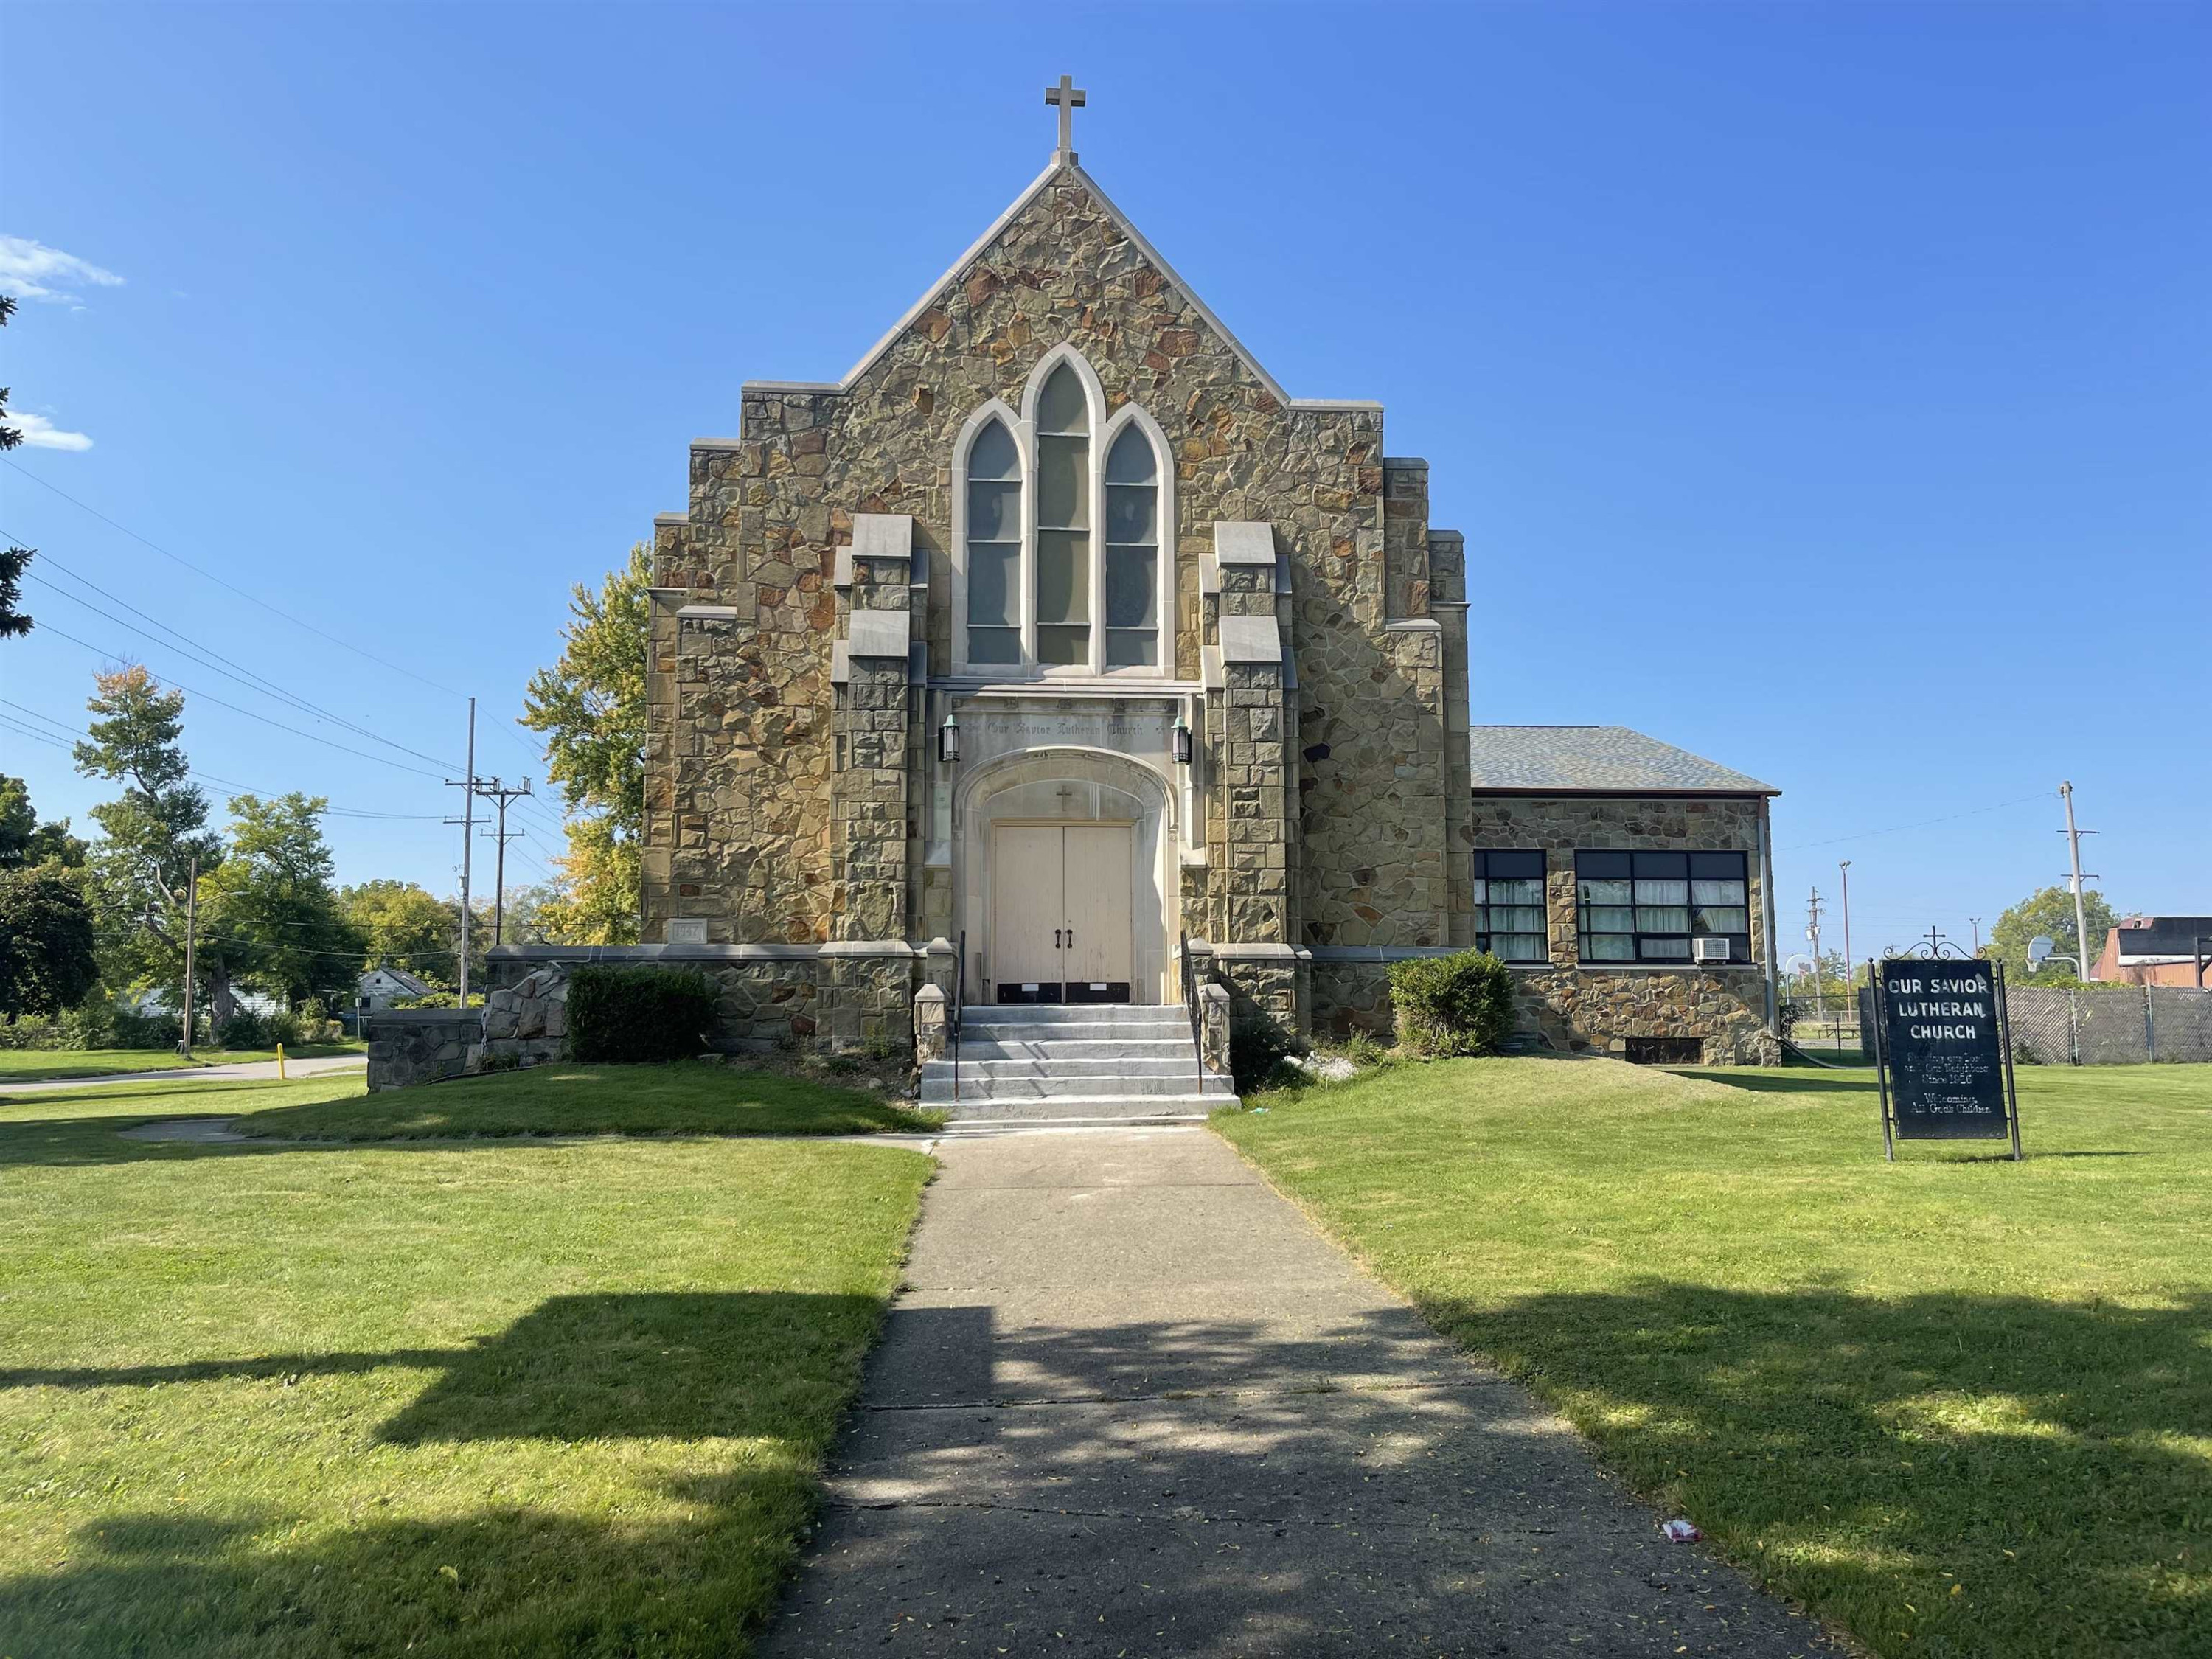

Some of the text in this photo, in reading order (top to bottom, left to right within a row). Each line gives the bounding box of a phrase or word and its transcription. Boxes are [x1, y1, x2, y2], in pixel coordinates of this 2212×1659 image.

[987, 722, 1143, 735] Our Savior Lutheran Church
[1888, 978, 1992, 994] OUR SAVIOR
[1899, 1002, 1986, 1018] LUTHERAN
[1910, 1025, 1976, 1039] CHURCH
[1964, 1052, 1984, 1062] Lor
[1905, 1062, 1921, 1072] an
